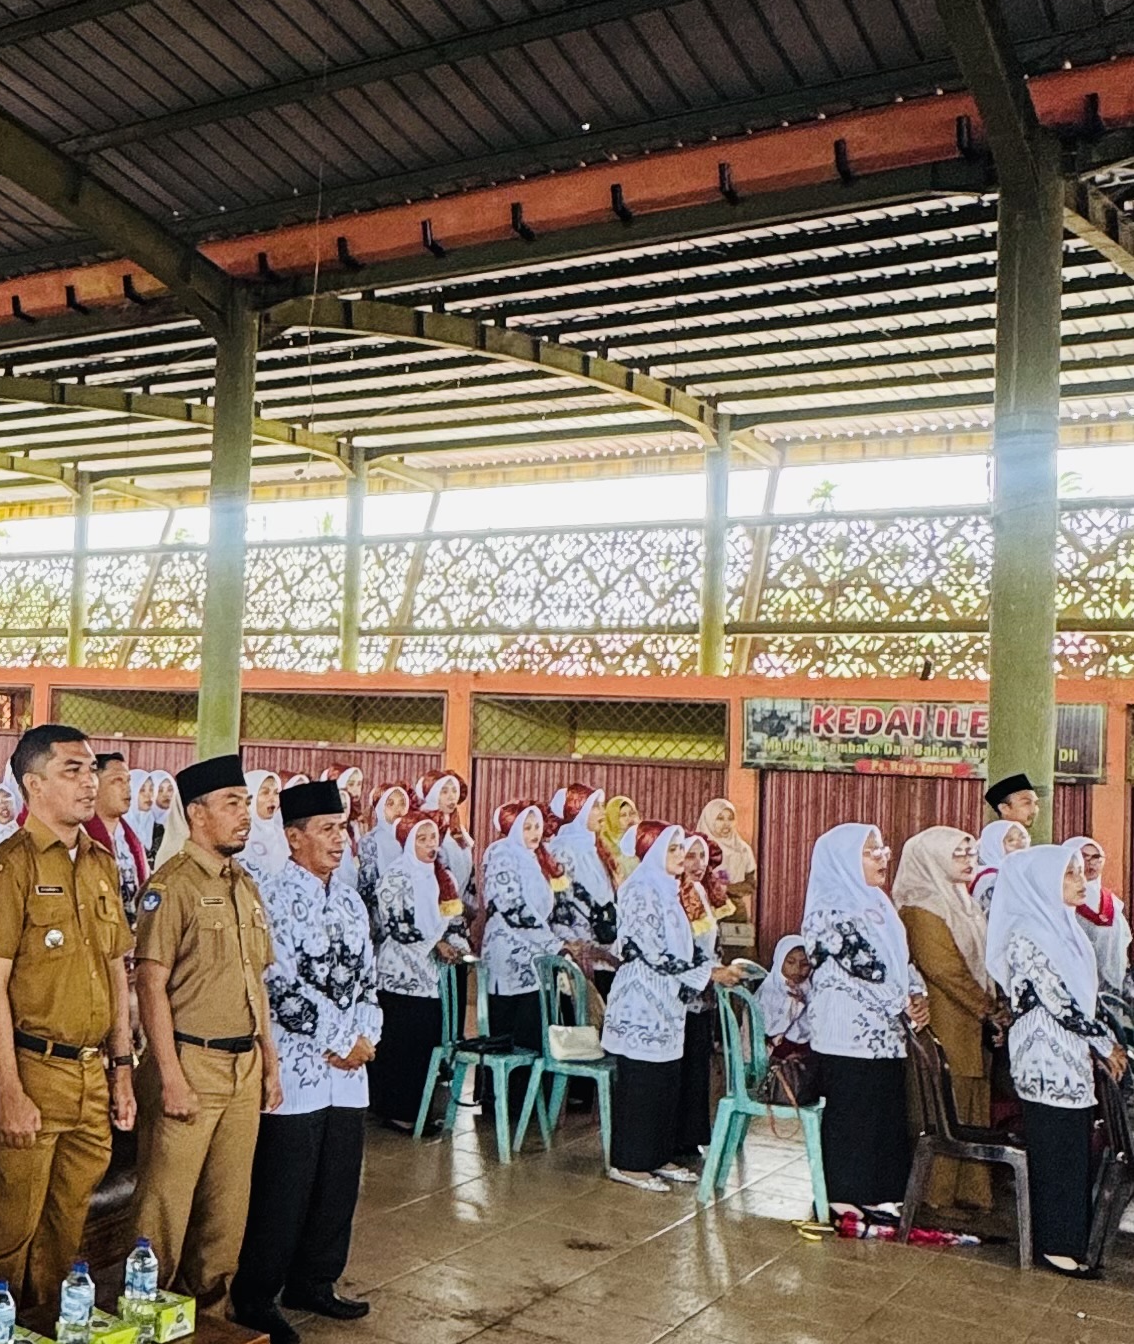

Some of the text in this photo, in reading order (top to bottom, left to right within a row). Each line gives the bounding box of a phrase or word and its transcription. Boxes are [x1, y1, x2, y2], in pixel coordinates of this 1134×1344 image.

[811, 705, 924, 739] KEDAI
[819, 738, 879, 755] Sembako
[884, 743, 909, 756] Dan
[913, 743, 957, 757] Bahan
